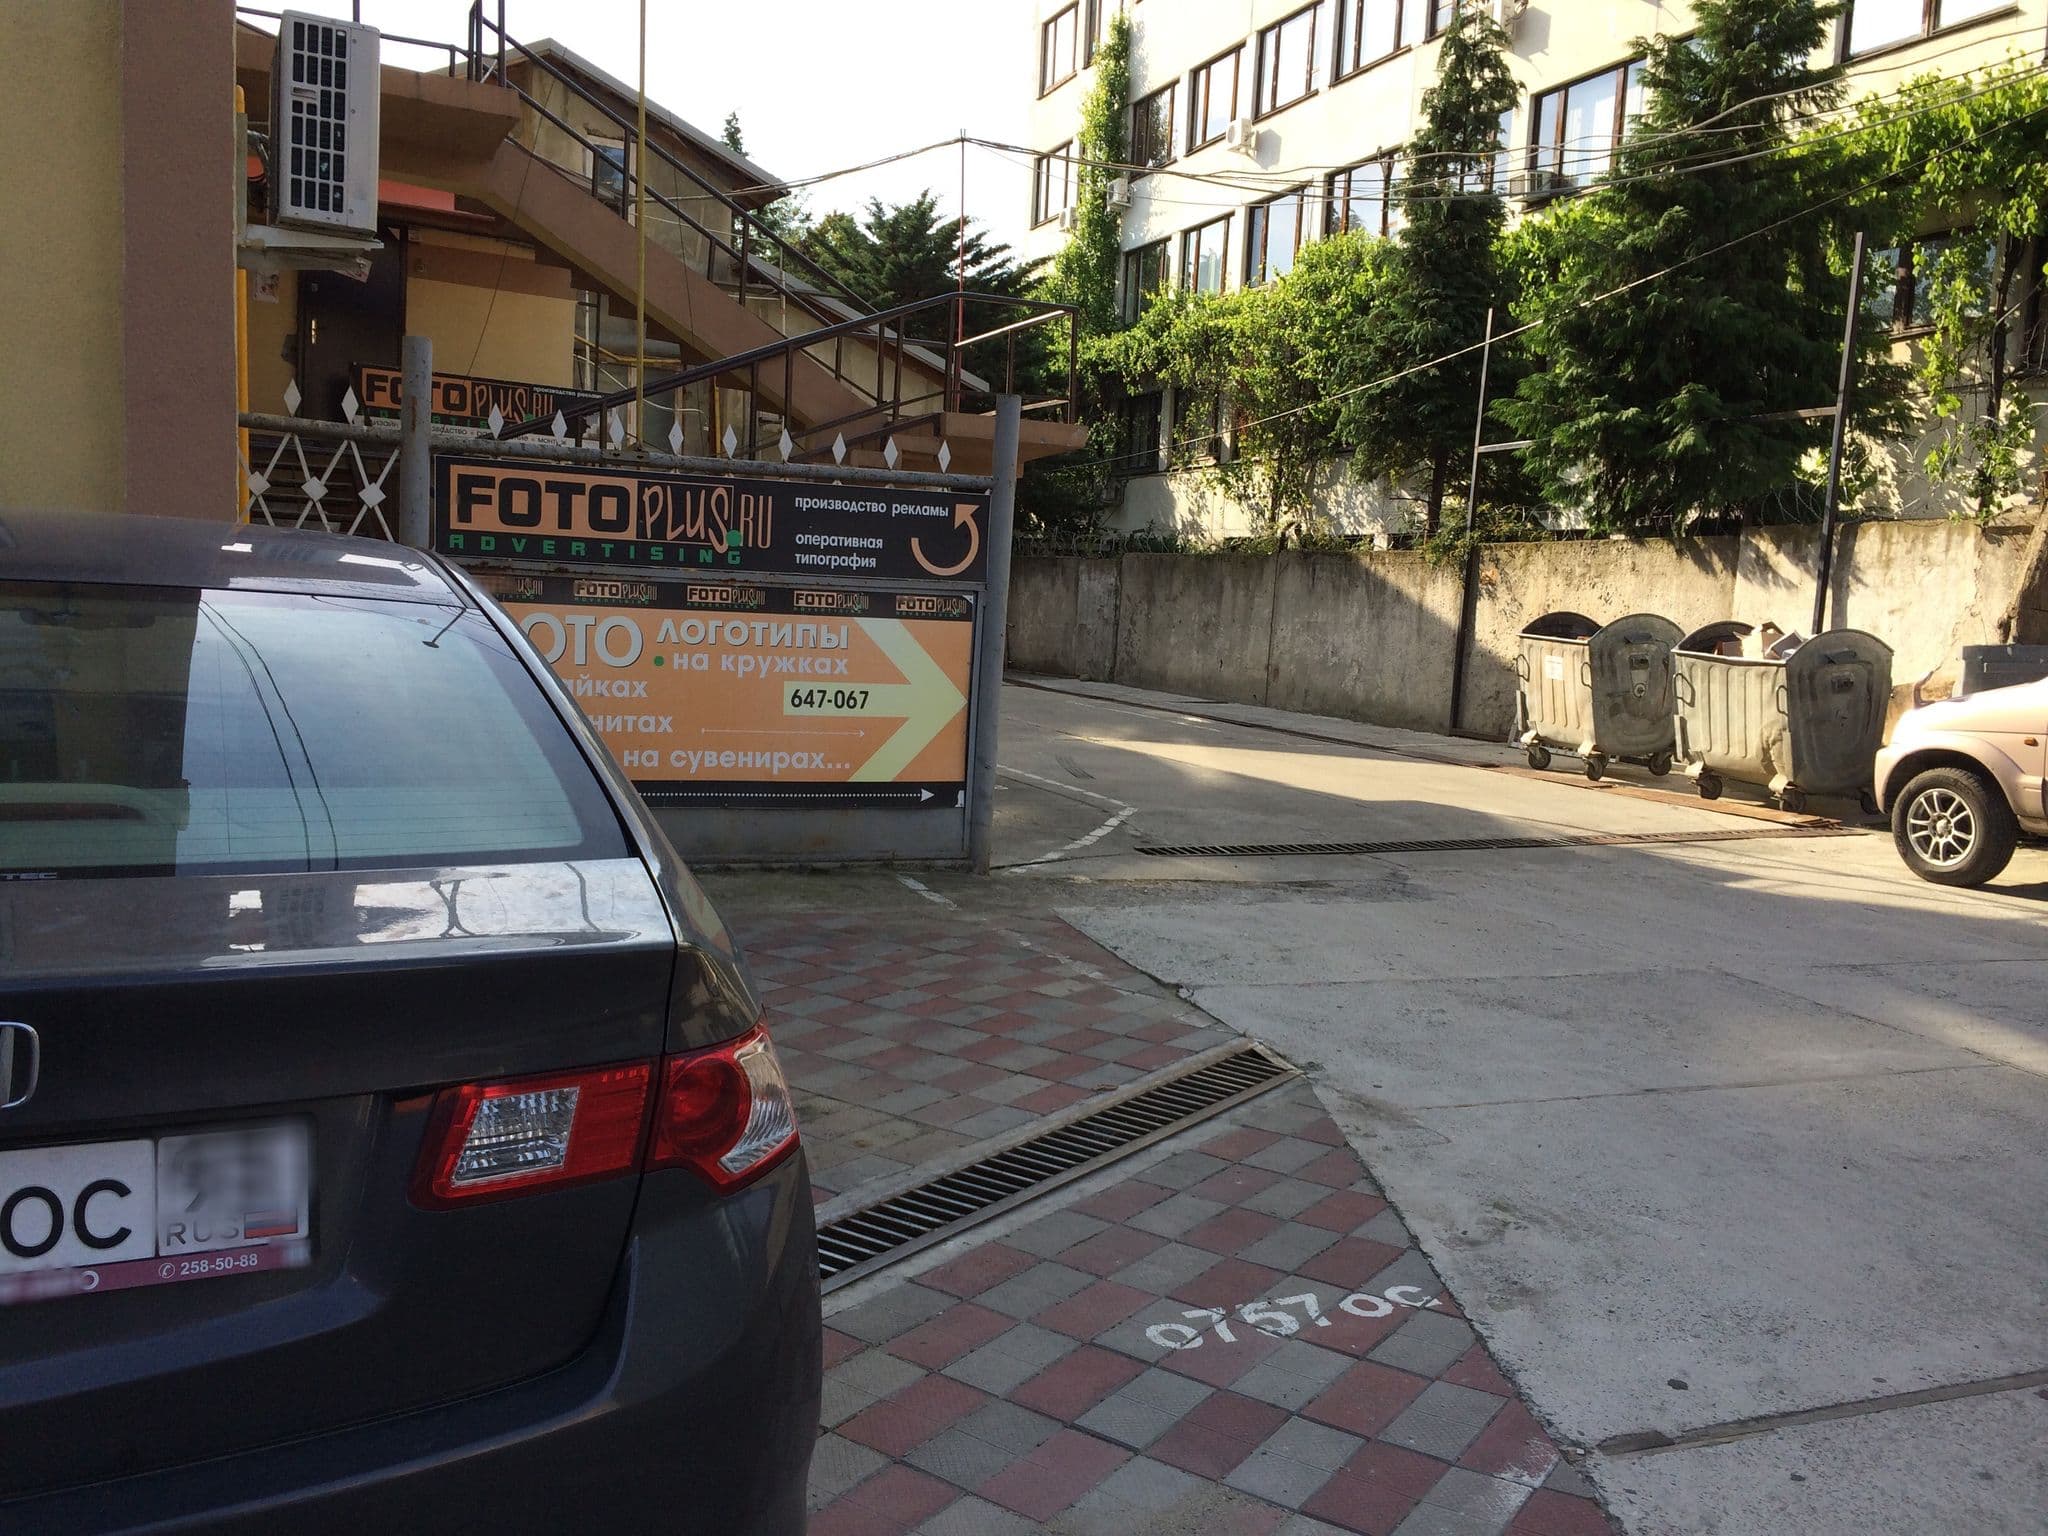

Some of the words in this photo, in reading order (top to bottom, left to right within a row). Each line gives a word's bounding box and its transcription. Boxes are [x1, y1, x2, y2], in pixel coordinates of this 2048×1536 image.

[795, 497, 887, 513] производство
[892, 502, 949, 517] рекламы
[449, 533, 742, 565] ADVERTISING
[795, 533, 883, 549] оперативная
[795, 552, 876, 570] типография
[656, 618, 849, 649] ЛОГОТИПЫ
[673, 653, 709, 671] на
[721, 654, 849, 678] кружках
[790, 688, 869, 711] 647-067
[623, 750, 659, 767] на
[670, 750, 850, 775] сувенирах...
[180, 1253, 258, 1276] 258-50-88
